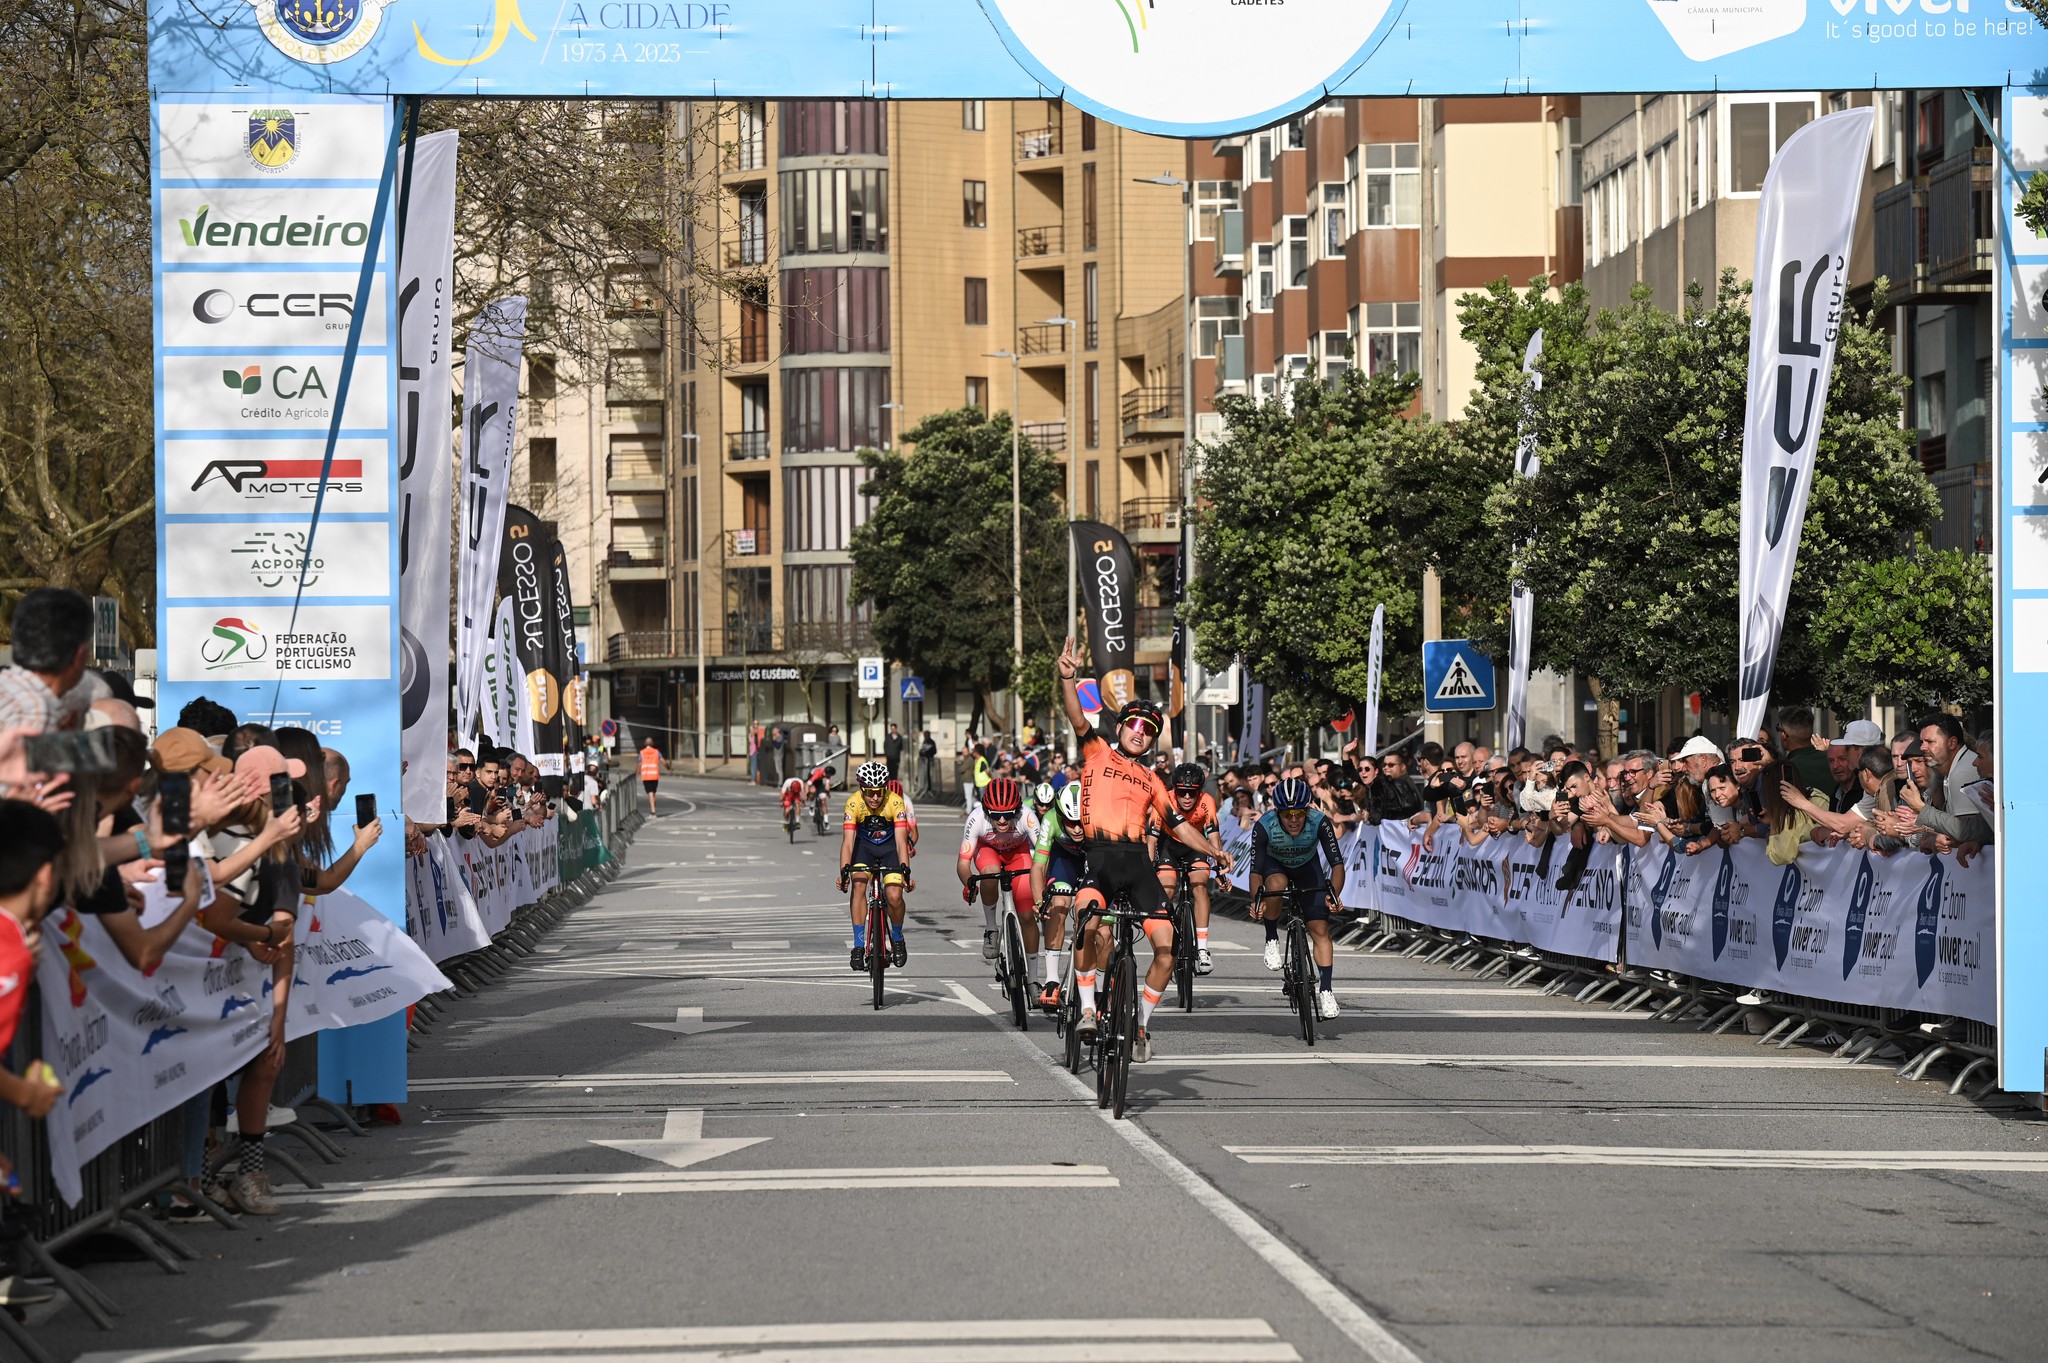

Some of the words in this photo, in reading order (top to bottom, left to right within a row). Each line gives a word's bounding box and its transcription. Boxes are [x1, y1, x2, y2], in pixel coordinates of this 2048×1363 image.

[567, 3, 592, 28] A
[600, 3, 732, 29] CIDADE
[1722, 6, 1764, 14] MUNICIPAL
[308, 49, 327, 61] DE
[330, 18, 375, 58] VARZIM
[1869, 19, 1917, 43] good
[1925, 21, 1946, 37] to
[1954, 18, 1977, 36] be
[1985, 17, 2033, 36] here!
[561, 43, 606, 63] 1973
[610, 44, 628, 63] A
[635, 43, 681, 63] 2023
[179, 204, 368, 247] Vendeiro
[431, 277, 443, 364] GRUPO
[273, 365, 328, 399] CA
[241, 408, 281, 418] Crédito
[285, 408, 329, 420] Agrícola
[249, 483, 363, 493] MOTORS
[251, 559, 324, 569] ACPORTO
[276, 632, 347, 646] FEDERAÇÃO
[276, 647, 356, 657] PORTUGUESA
[276, 659, 291, 669] DE
[295, 659, 351, 669] CICLISMO
[749, 669, 760, 680] OS
[865, 667, 876, 679] P
[1103, 766, 1156, 798] EFAPEL
[1084, 769, 1094, 826] EFAPEL
[1321, 821, 1338, 853] PROTEU
[1804, 878, 1824, 912] bom
[1941, 870, 1951, 919] É
[1949, 880, 1966, 920] bom
[1792, 917, 1812, 951] viver
[1862, 923, 1882, 958] viver
[322, 936, 374, 962] Varzim
[1939, 926, 1962, 966] viver
[1963, 932, 1981, 981] aqui!
